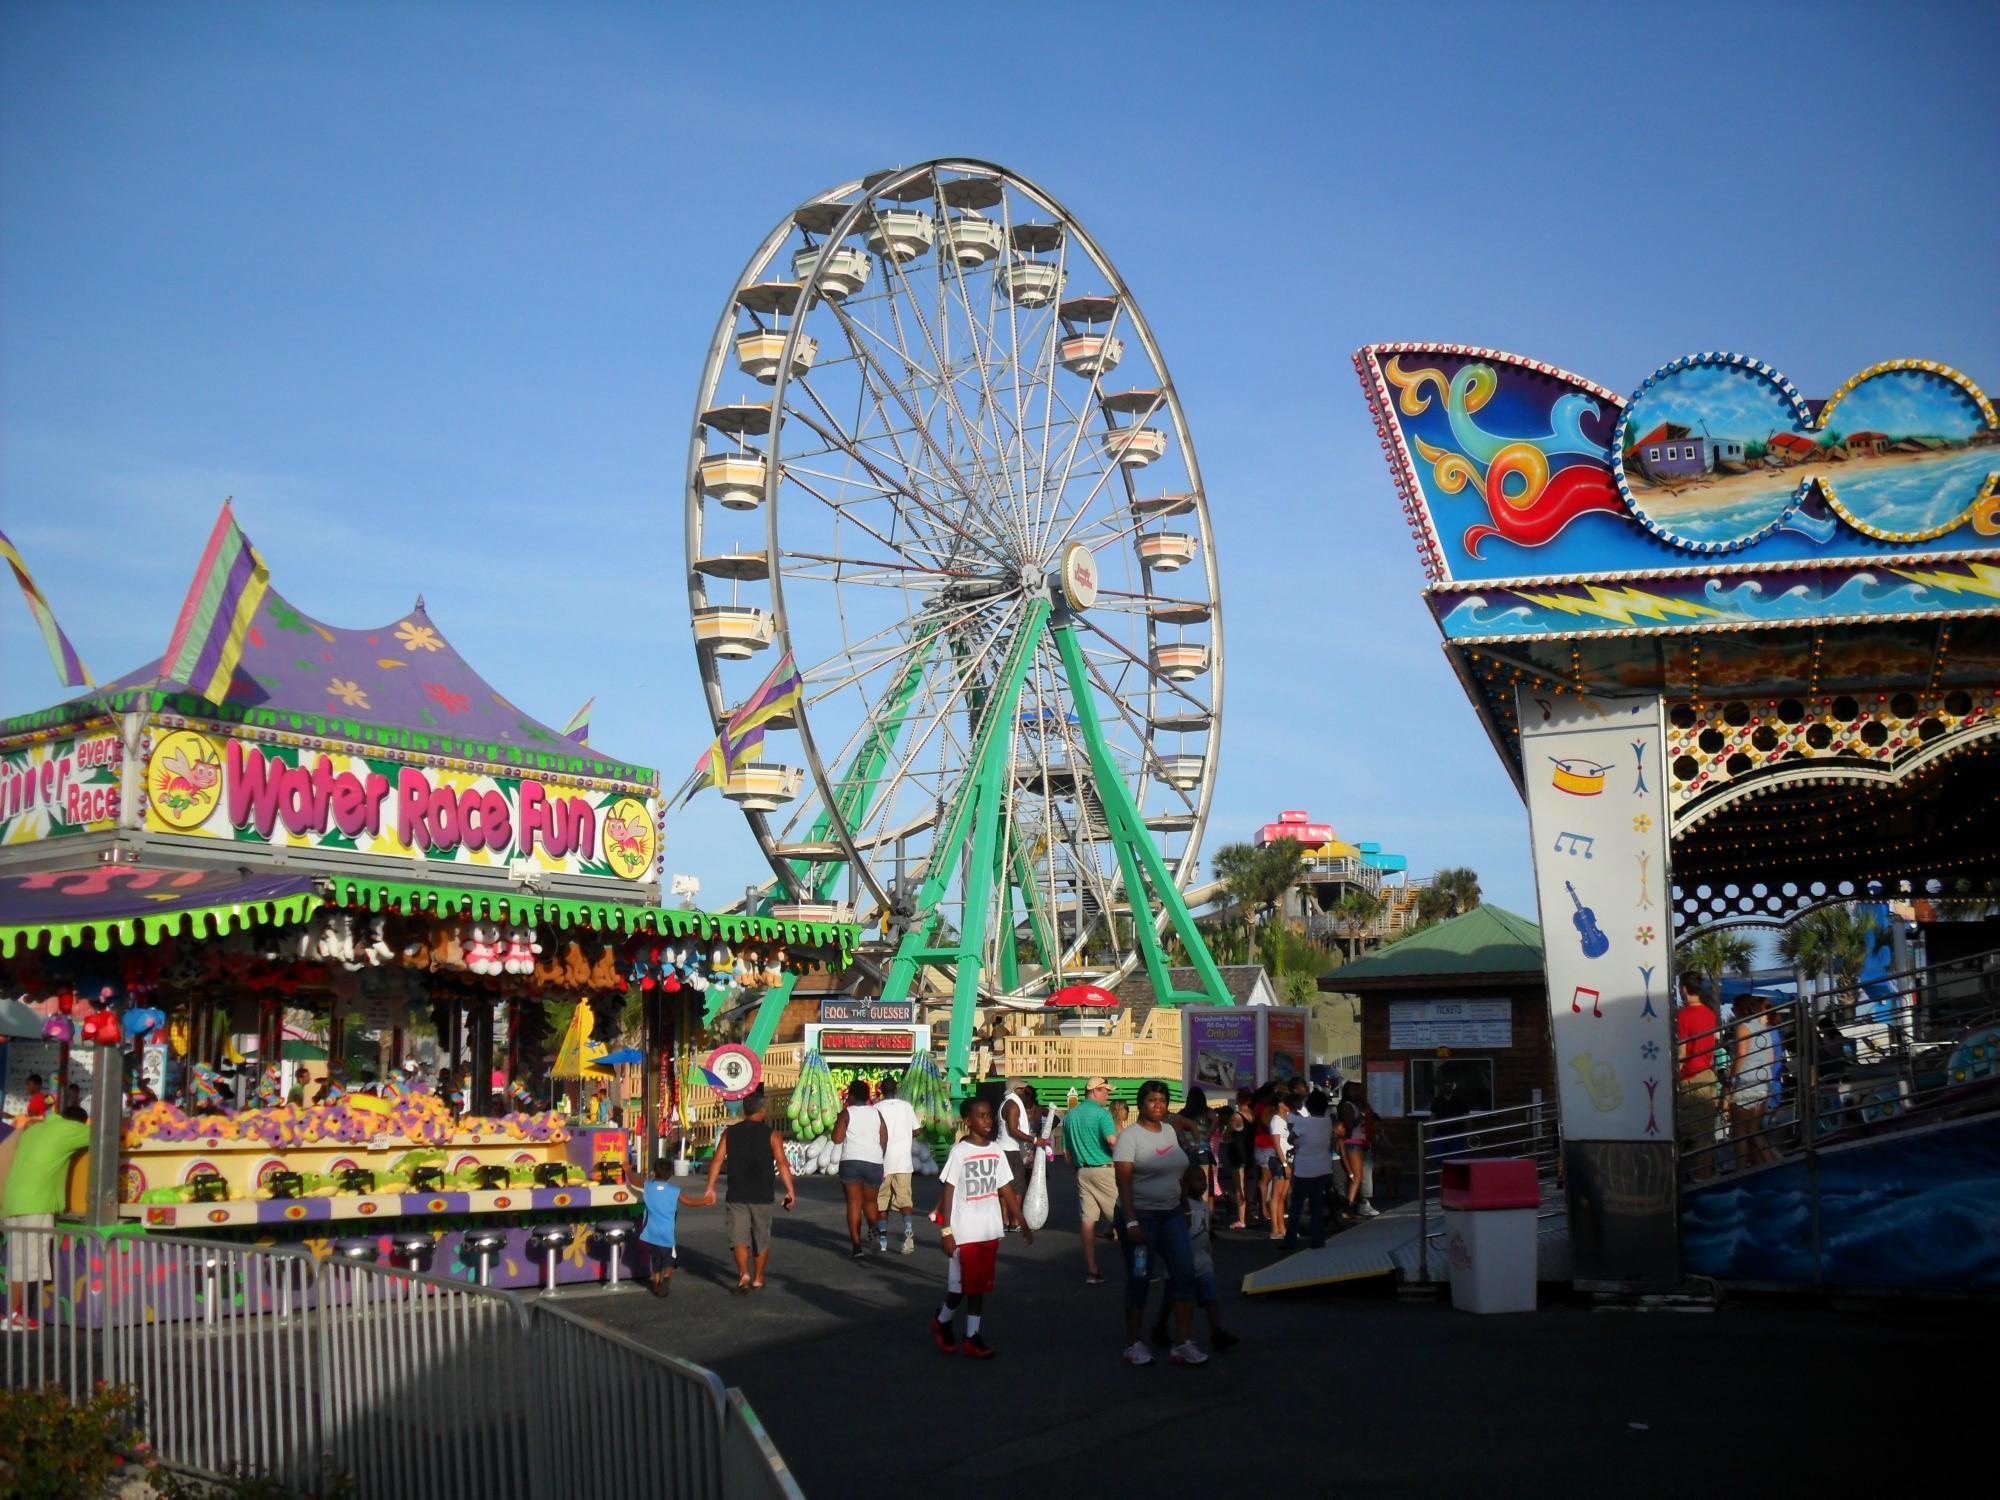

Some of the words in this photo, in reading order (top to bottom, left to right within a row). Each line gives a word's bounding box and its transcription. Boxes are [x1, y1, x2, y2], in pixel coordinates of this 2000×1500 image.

[77, 736, 117, 772] every
[66, 783, 119, 825] Race
[227, 738, 391, 840] Water
[397, 766, 513, 853] Race
[520, 779, 597, 862] Fun
[824, 1006, 849, 1019] FOOL
[851, 1009, 867, 1018] THE
[870, 1006, 910, 1019] GUESSER
[1436, 1004, 1463, 1015] TICKETS
[1207, 1028, 1226, 1039] Only
